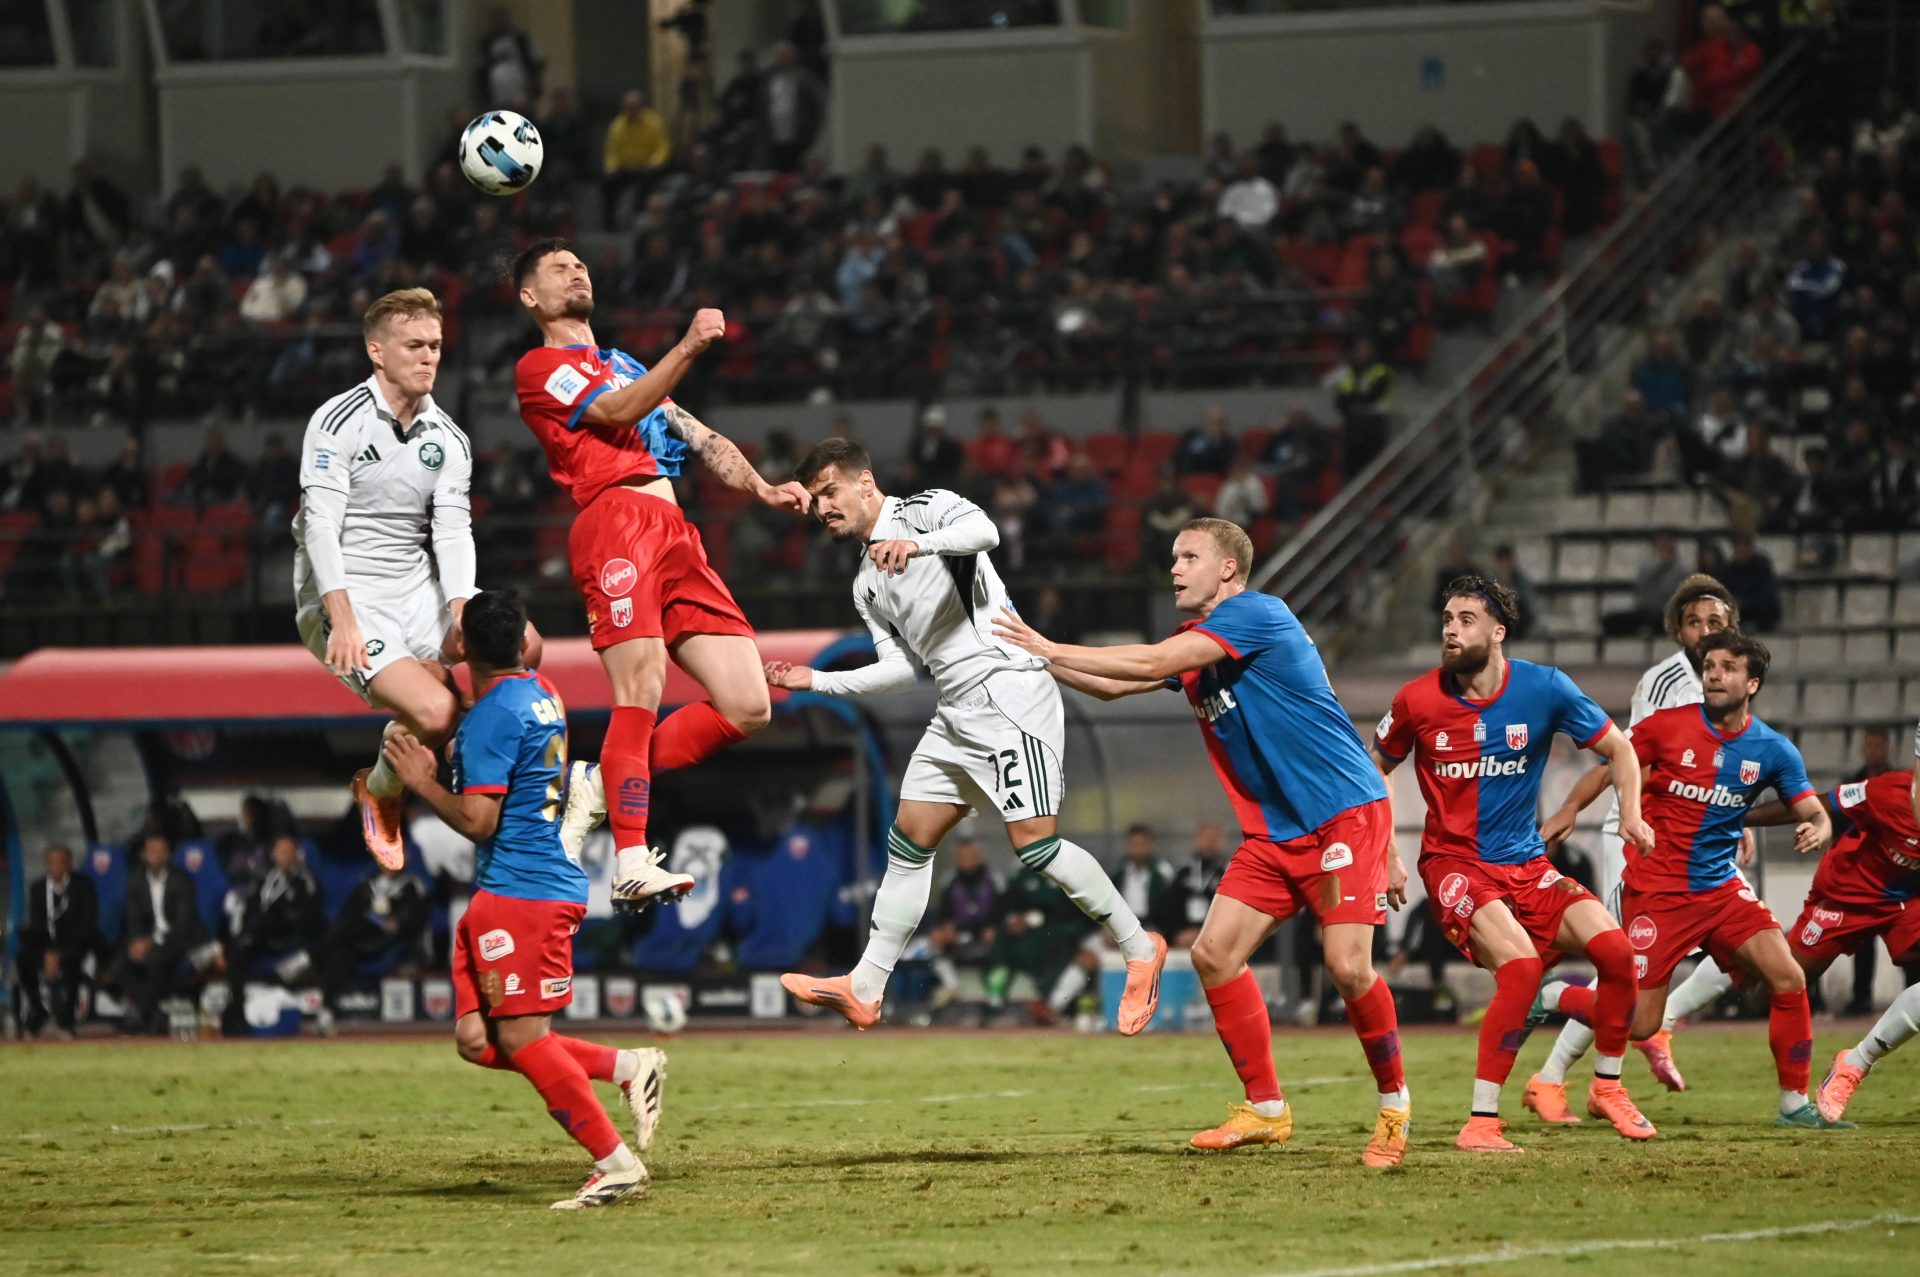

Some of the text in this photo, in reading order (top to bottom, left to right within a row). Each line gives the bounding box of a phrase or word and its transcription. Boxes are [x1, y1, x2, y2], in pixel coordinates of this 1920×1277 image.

[987, 748, 1023, 793] 12
[1434, 754, 1528, 779] novibet
[1668, 780, 1746, 808] novibe
[1324, 847, 1346, 863] Dole
[484, 934, 506, 952] Dole
